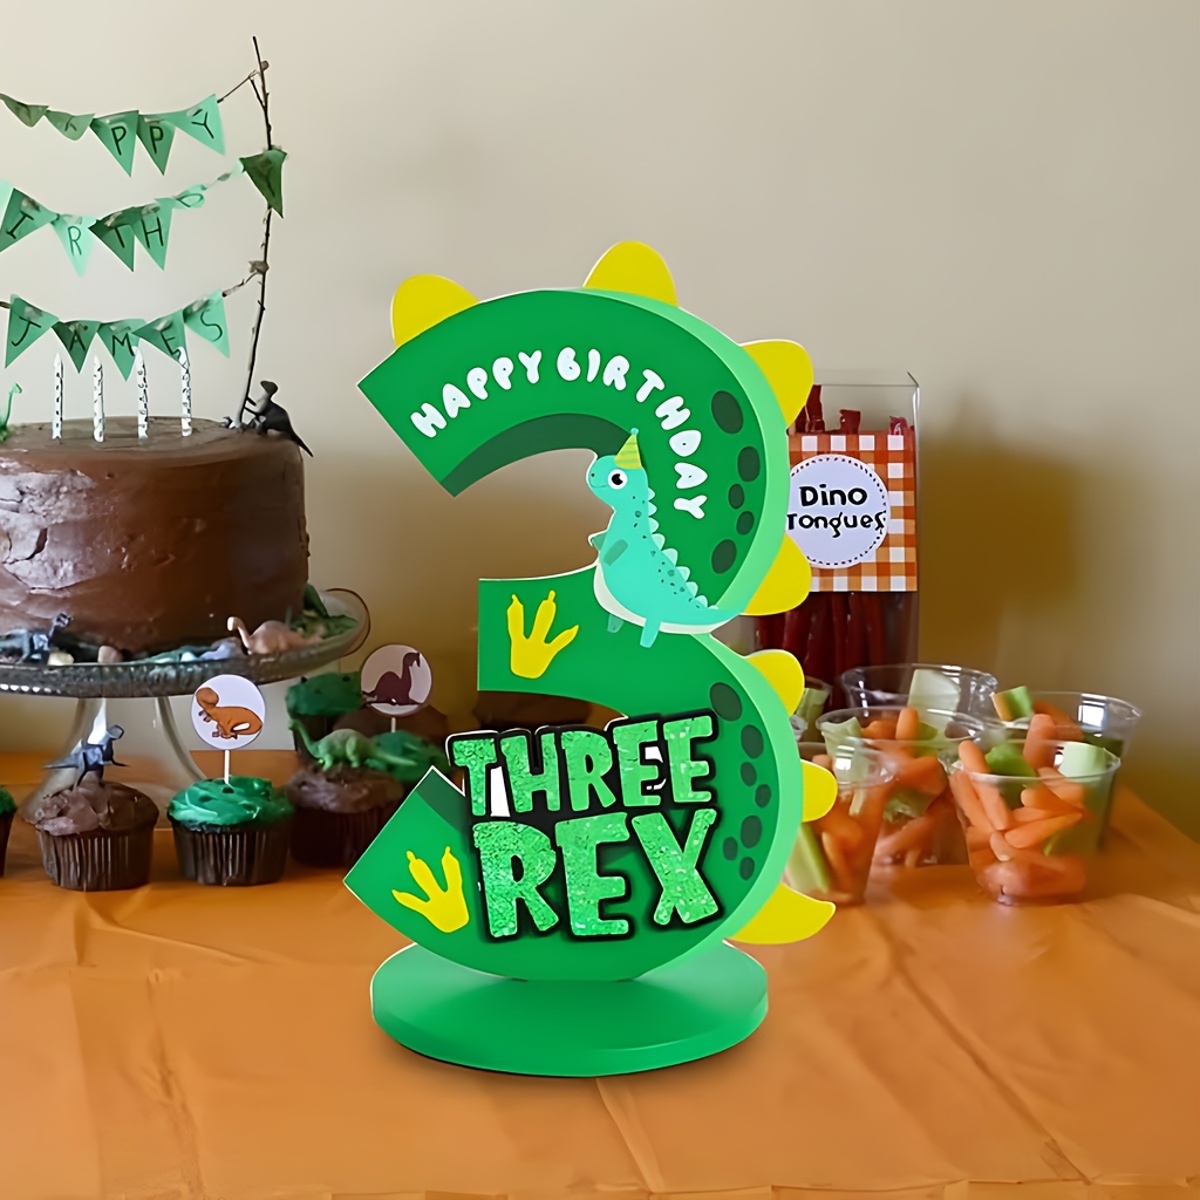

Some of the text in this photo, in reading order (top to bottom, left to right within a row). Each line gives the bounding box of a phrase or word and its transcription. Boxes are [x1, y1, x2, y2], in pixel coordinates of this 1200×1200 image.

[11, 308, 224, 359] JAMES
[410, 347, 708, 519] HAPPY BIRTHDAY
[786, 510, 887, 539] Tongues
[798, 483, 869, 508] Dino
[448, 715, 714, 817] THREE
[472, 807, 720, 938] REX
